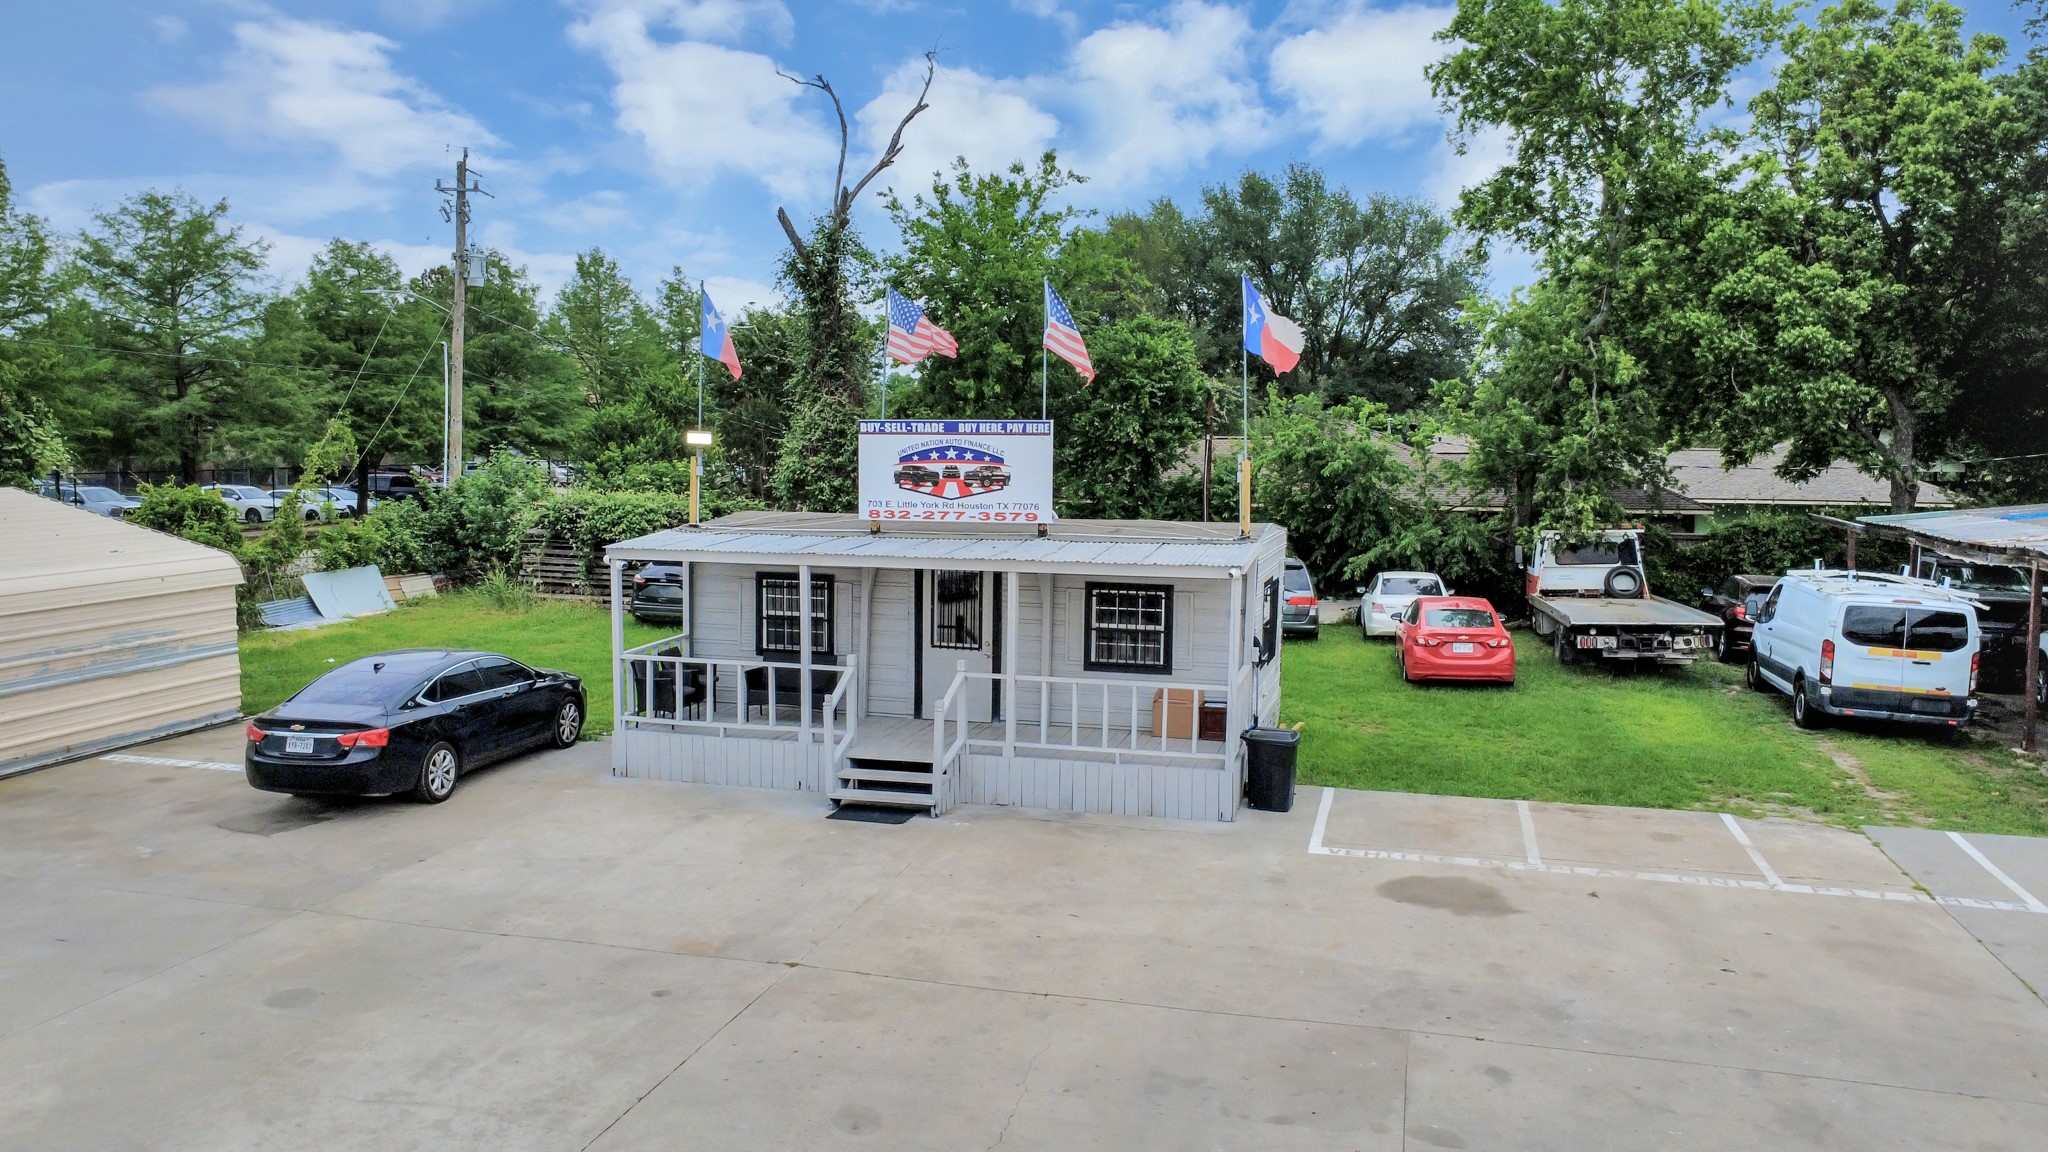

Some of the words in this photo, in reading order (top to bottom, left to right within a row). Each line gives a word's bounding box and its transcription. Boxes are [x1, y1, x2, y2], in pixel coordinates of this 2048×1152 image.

[860, 422, 945, 433] BUY-SELL-TRADE
[958, 422, 977, 433] BUY
[979, 422, 1005, 434] HERE,
[1006, 423, 1024, 433] PAY
[1025, 423, 1050, 433] HERE
[897, 443, 920, 456] UNITED
[920, 439, 944, 448] NATION
[945, 438, 963, 446] AUTO
[963, 440, 992, 452] FINANCE
[992, 448, 1005, 457] LLC
[867, 500, 883, 508] 703
[920, 501, 940, 509] York
[942, 501, 955, 509] Rd
[957, 502, 994, 510] Houston
[995, 502, 1009, 510] TX
[1012, 502, 1040, 511] 77076
[868, 509, 1039, 522] 832-277-3579
[1328, 848, 1456, 863] VEHICLE
